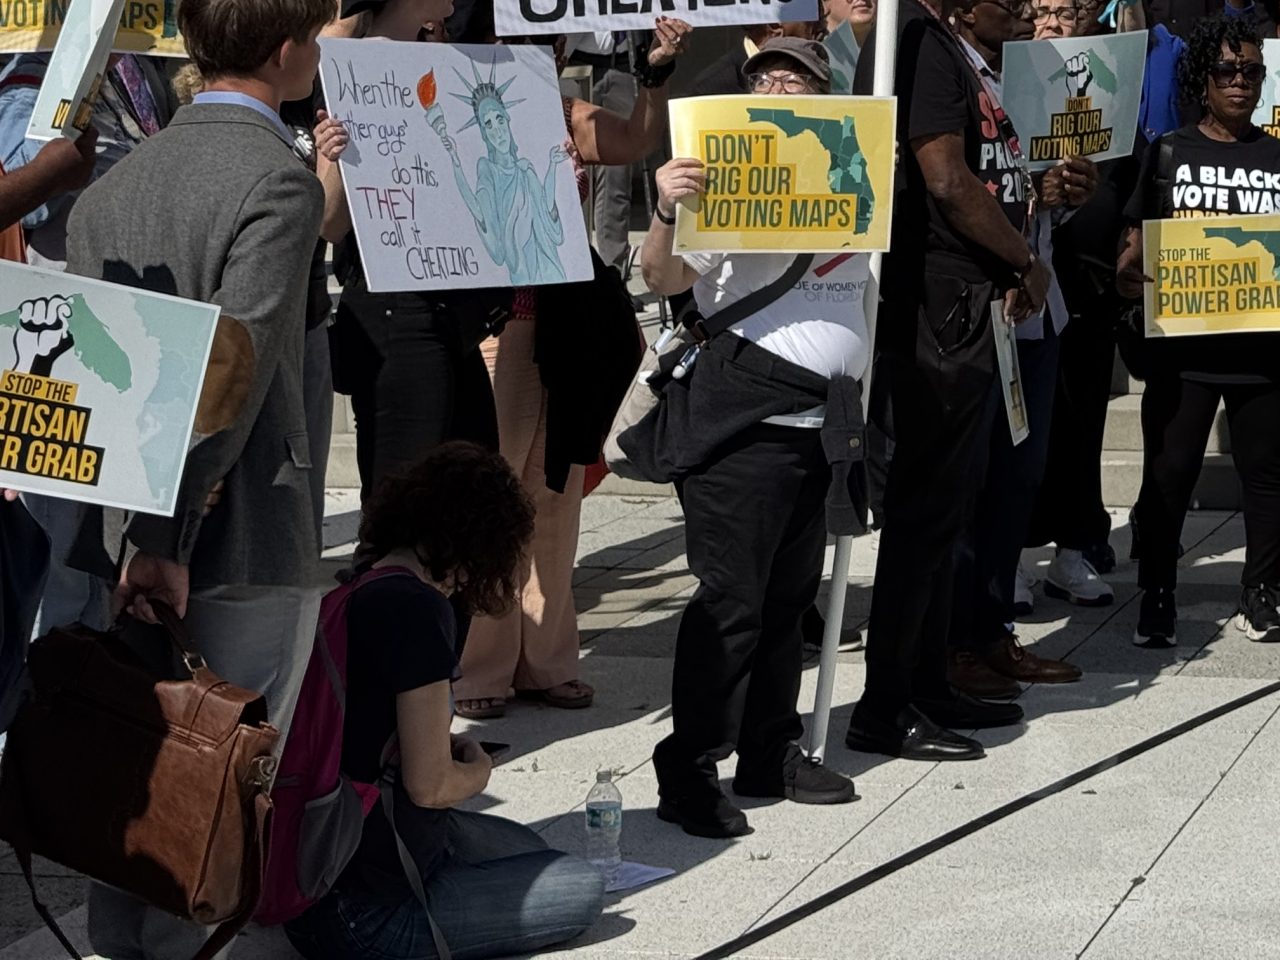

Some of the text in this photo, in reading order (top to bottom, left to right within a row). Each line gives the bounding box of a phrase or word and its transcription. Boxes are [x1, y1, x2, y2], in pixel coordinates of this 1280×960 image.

[0, 0, 69, 27] VOTIN
[331, 58, 414, 109] When the
[1067, 98, 1090, 112] DON'T
[341, 111, 377, 141] ther
[1052, 111, 1101, 137] RIG OUR
[705, 134, 775, 164] DON'T
[1031, 130, 1112, 160] VOTING MAPS
[391, 155, 411, 186] do
[706, 166, 791, 196] RIG OUR
[1176, 163, 1192, 183] A
[355, 187, 416, 221] THEY
[1172, 185, 1229, 209] VOTE
[702, 198, 851, 228] VOTING MAPS
[380, 220, 422, 248] call it
[405, 245, 480, 281] CHEATING
[1158, 247, 1211, 263] STOP THE
[825, 281, 857, 292] WOMEN
[1157, 261, 1257, 289] PARTISAN
[1158, 290, 1229, 316] POWER
[4, 373, 73, 402] STOP THE
[0, 396, 86, 444] RTISAN
[26, 440, 98, 483] GRAB
